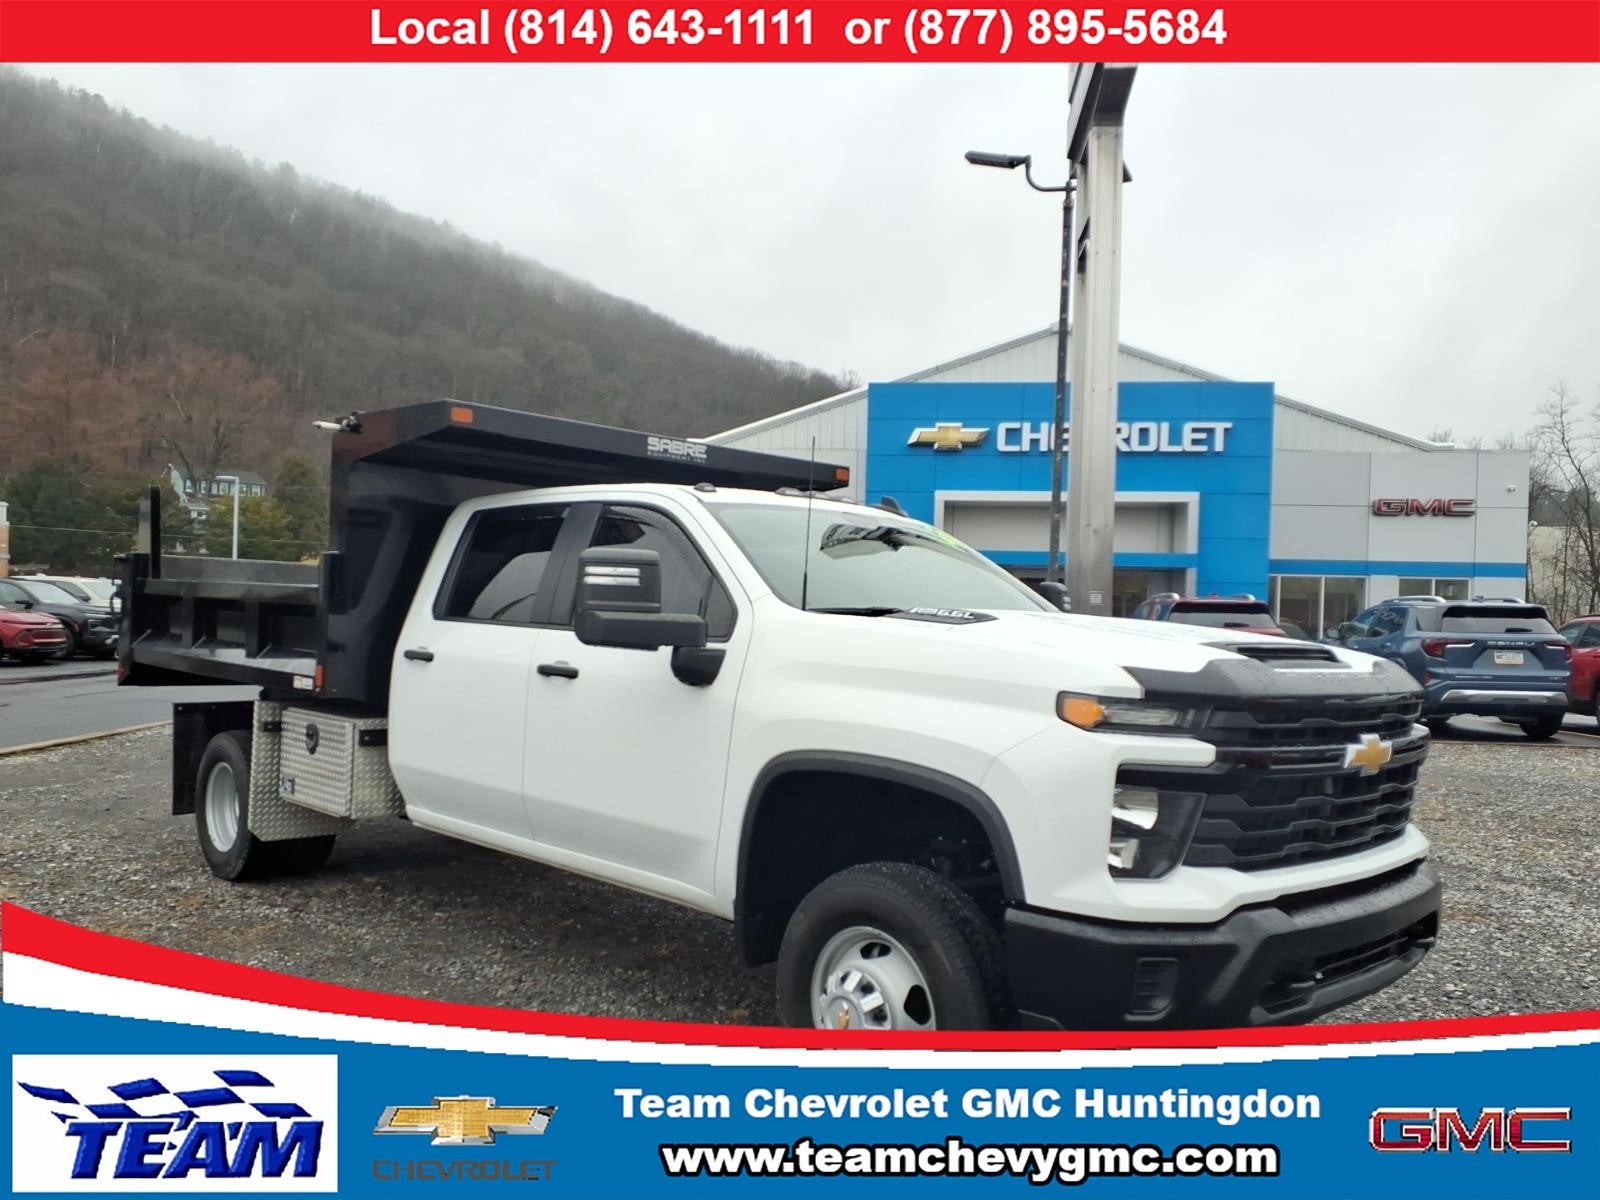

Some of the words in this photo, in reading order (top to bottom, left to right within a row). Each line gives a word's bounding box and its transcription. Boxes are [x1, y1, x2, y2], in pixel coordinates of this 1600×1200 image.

[647, 436, 707, 458] SABRE
[997, 421, 1232, 452] CHEROLET
[1373, 497, 1476, 516] GMC
